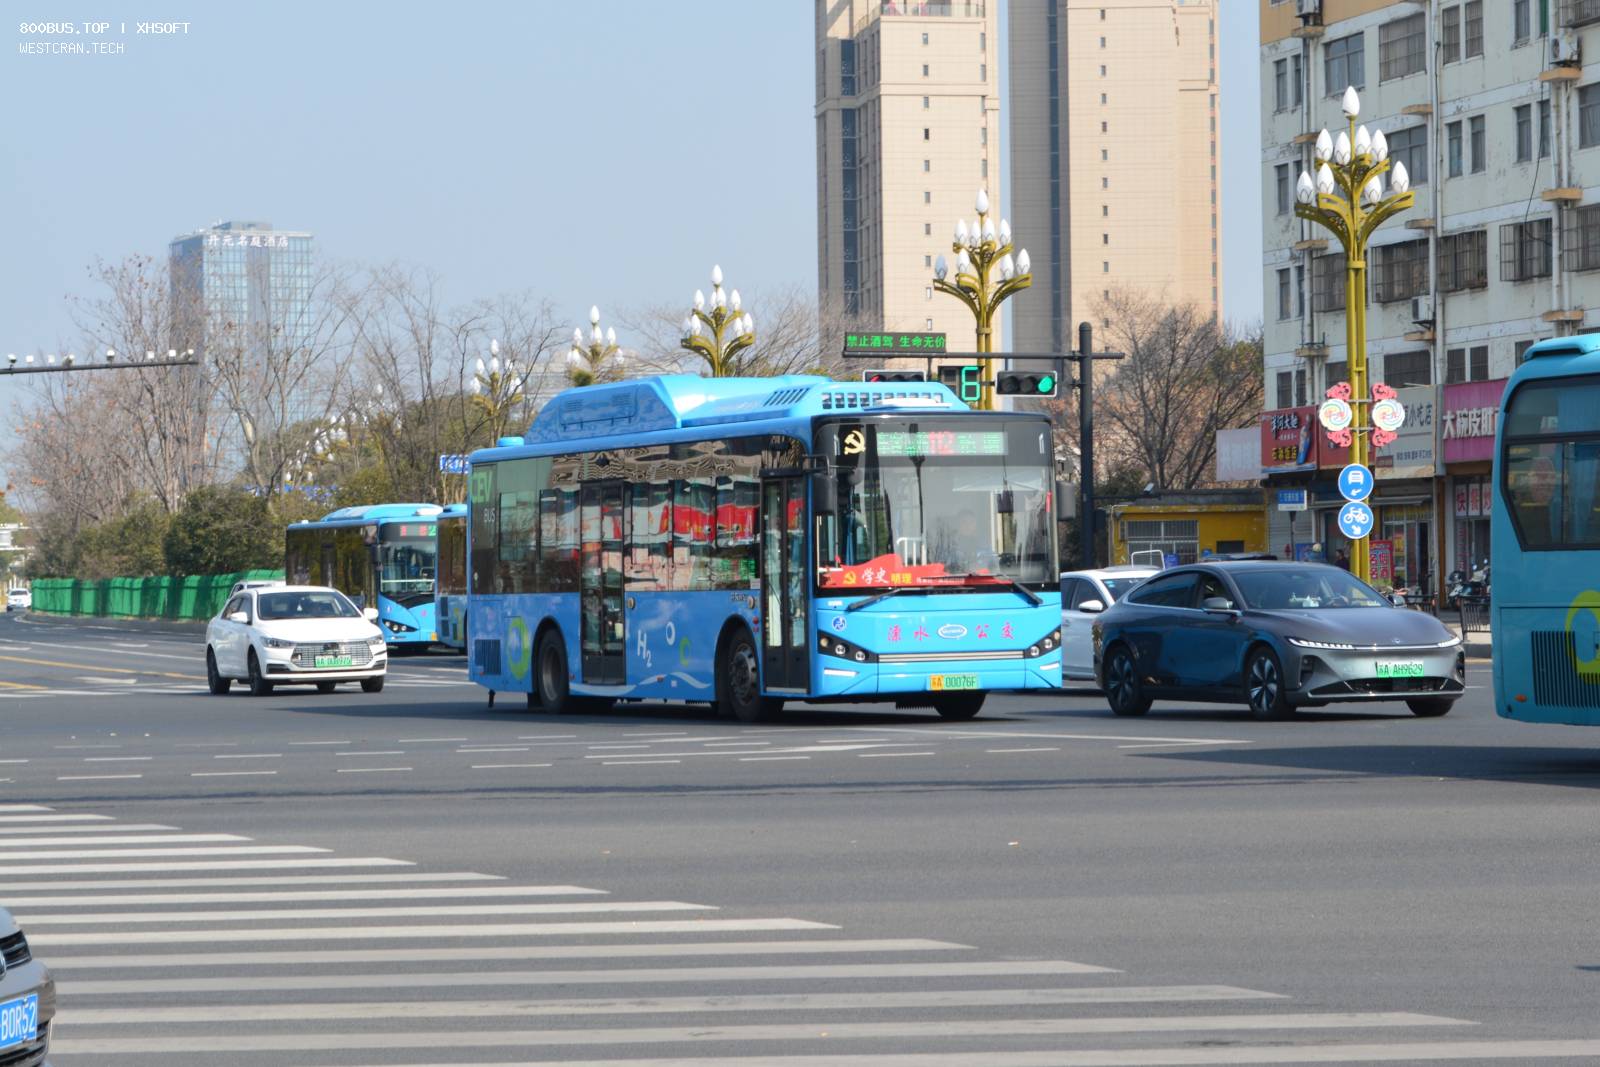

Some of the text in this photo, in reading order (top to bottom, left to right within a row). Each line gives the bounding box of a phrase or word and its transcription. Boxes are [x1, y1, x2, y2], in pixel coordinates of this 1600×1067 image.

[847, 335, 945, 348] 禁止酒驾 生命无价
[960, 366, 981, 401] 6
[484, 508, 496, 523] BUS
[887, 624, 929, 641] 溧水
[975, 622, 1015, 640] 公交
